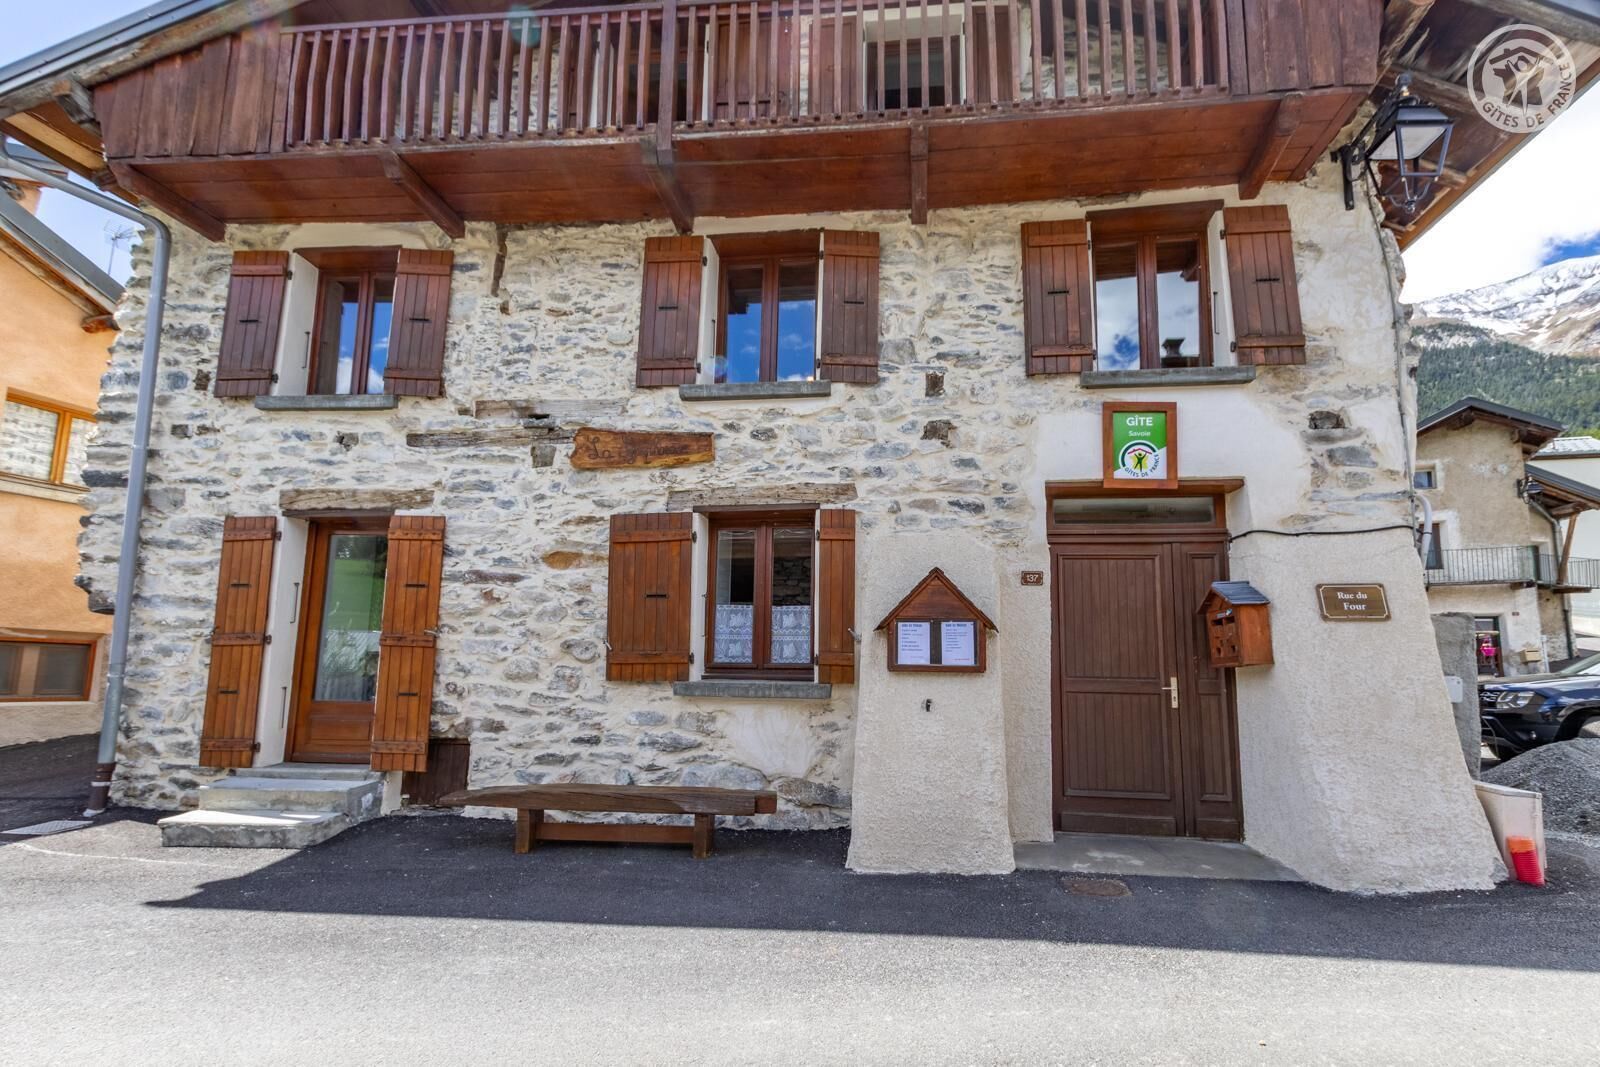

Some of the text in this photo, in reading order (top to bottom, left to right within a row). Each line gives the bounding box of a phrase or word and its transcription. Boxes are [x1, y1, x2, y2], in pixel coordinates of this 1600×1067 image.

[1126, 414, 1153, 426] GÎTE
[1026, 574, 1039, 582] 137
[1337, 591, 1368, 599] Rue du
[1343, 602, 1367, 611] Four
